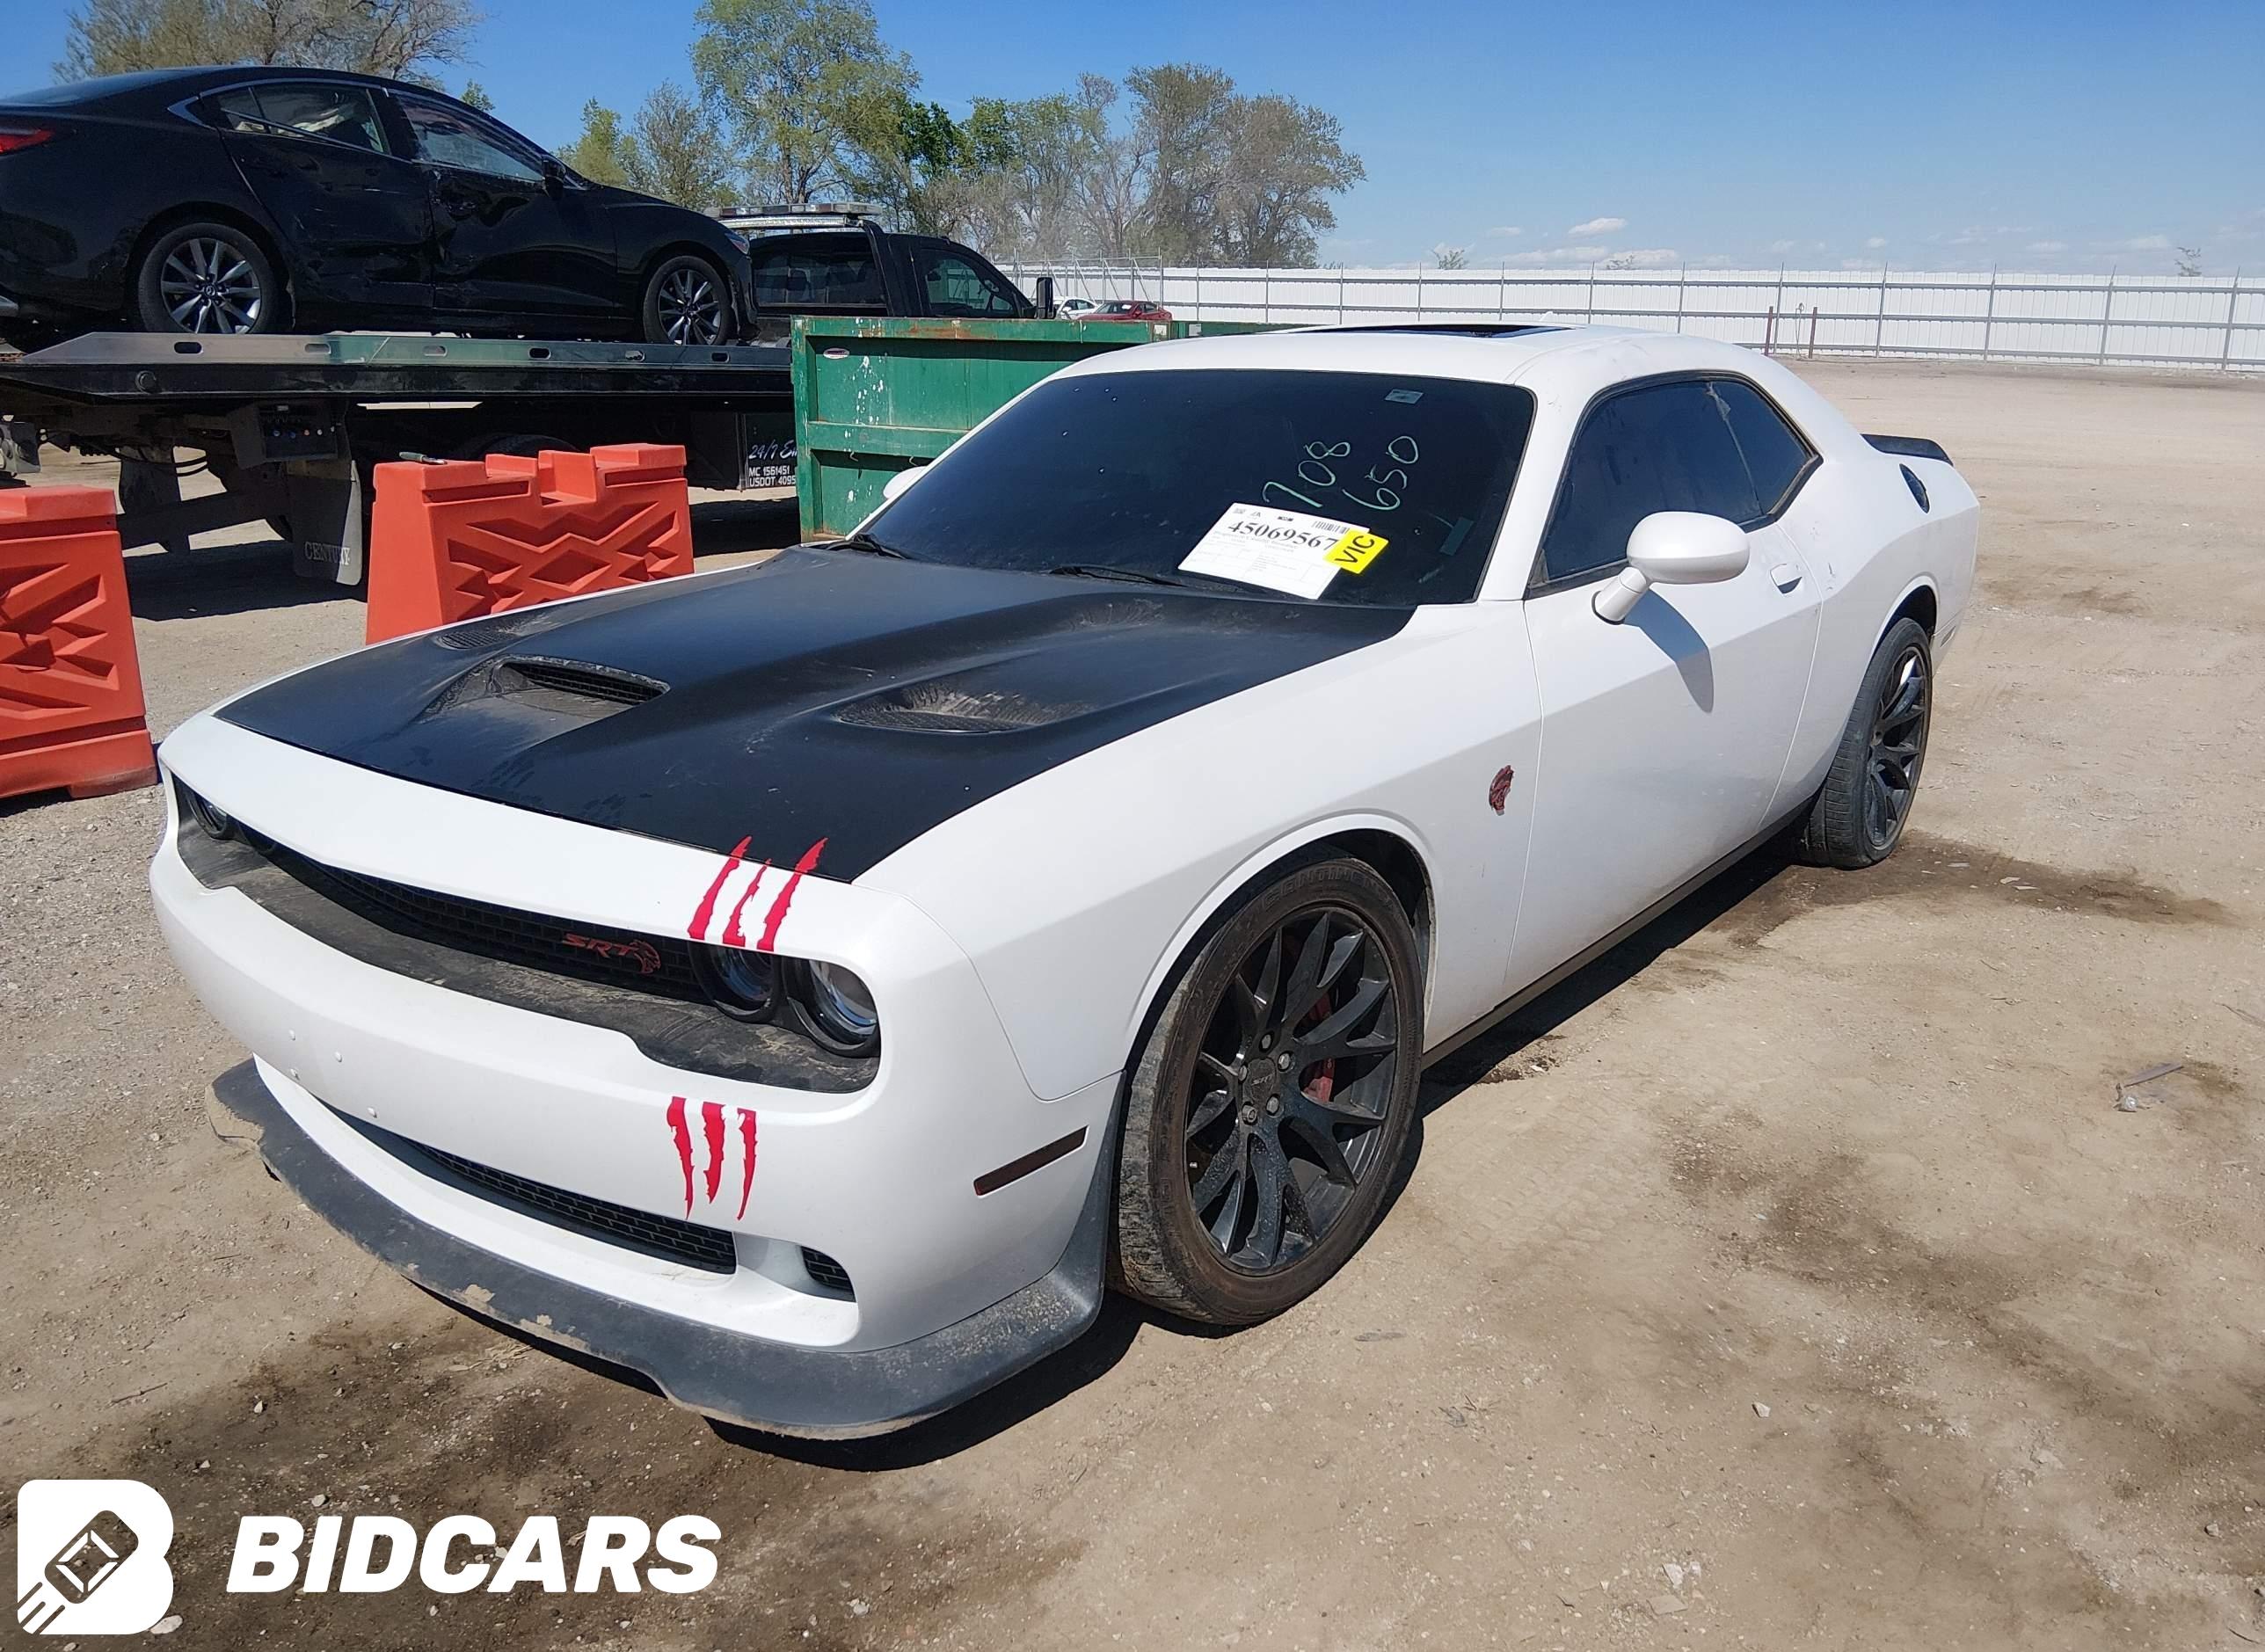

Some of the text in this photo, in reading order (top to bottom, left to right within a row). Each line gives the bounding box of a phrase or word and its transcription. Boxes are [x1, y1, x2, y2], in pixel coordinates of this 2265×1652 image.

[748, 440, 778, 460] 24/7
[748, 466, 761, 477] MC
[749, 477, 776, 487] USDOT
[1342, 436, 1419, 510] 650
[1228, 520, 1340, 551] 45069567
[304, 542, 351, 565] CENTURY
[1335, 535, 1376, 564] VIC
[561, 933, 639, 958] SRT
